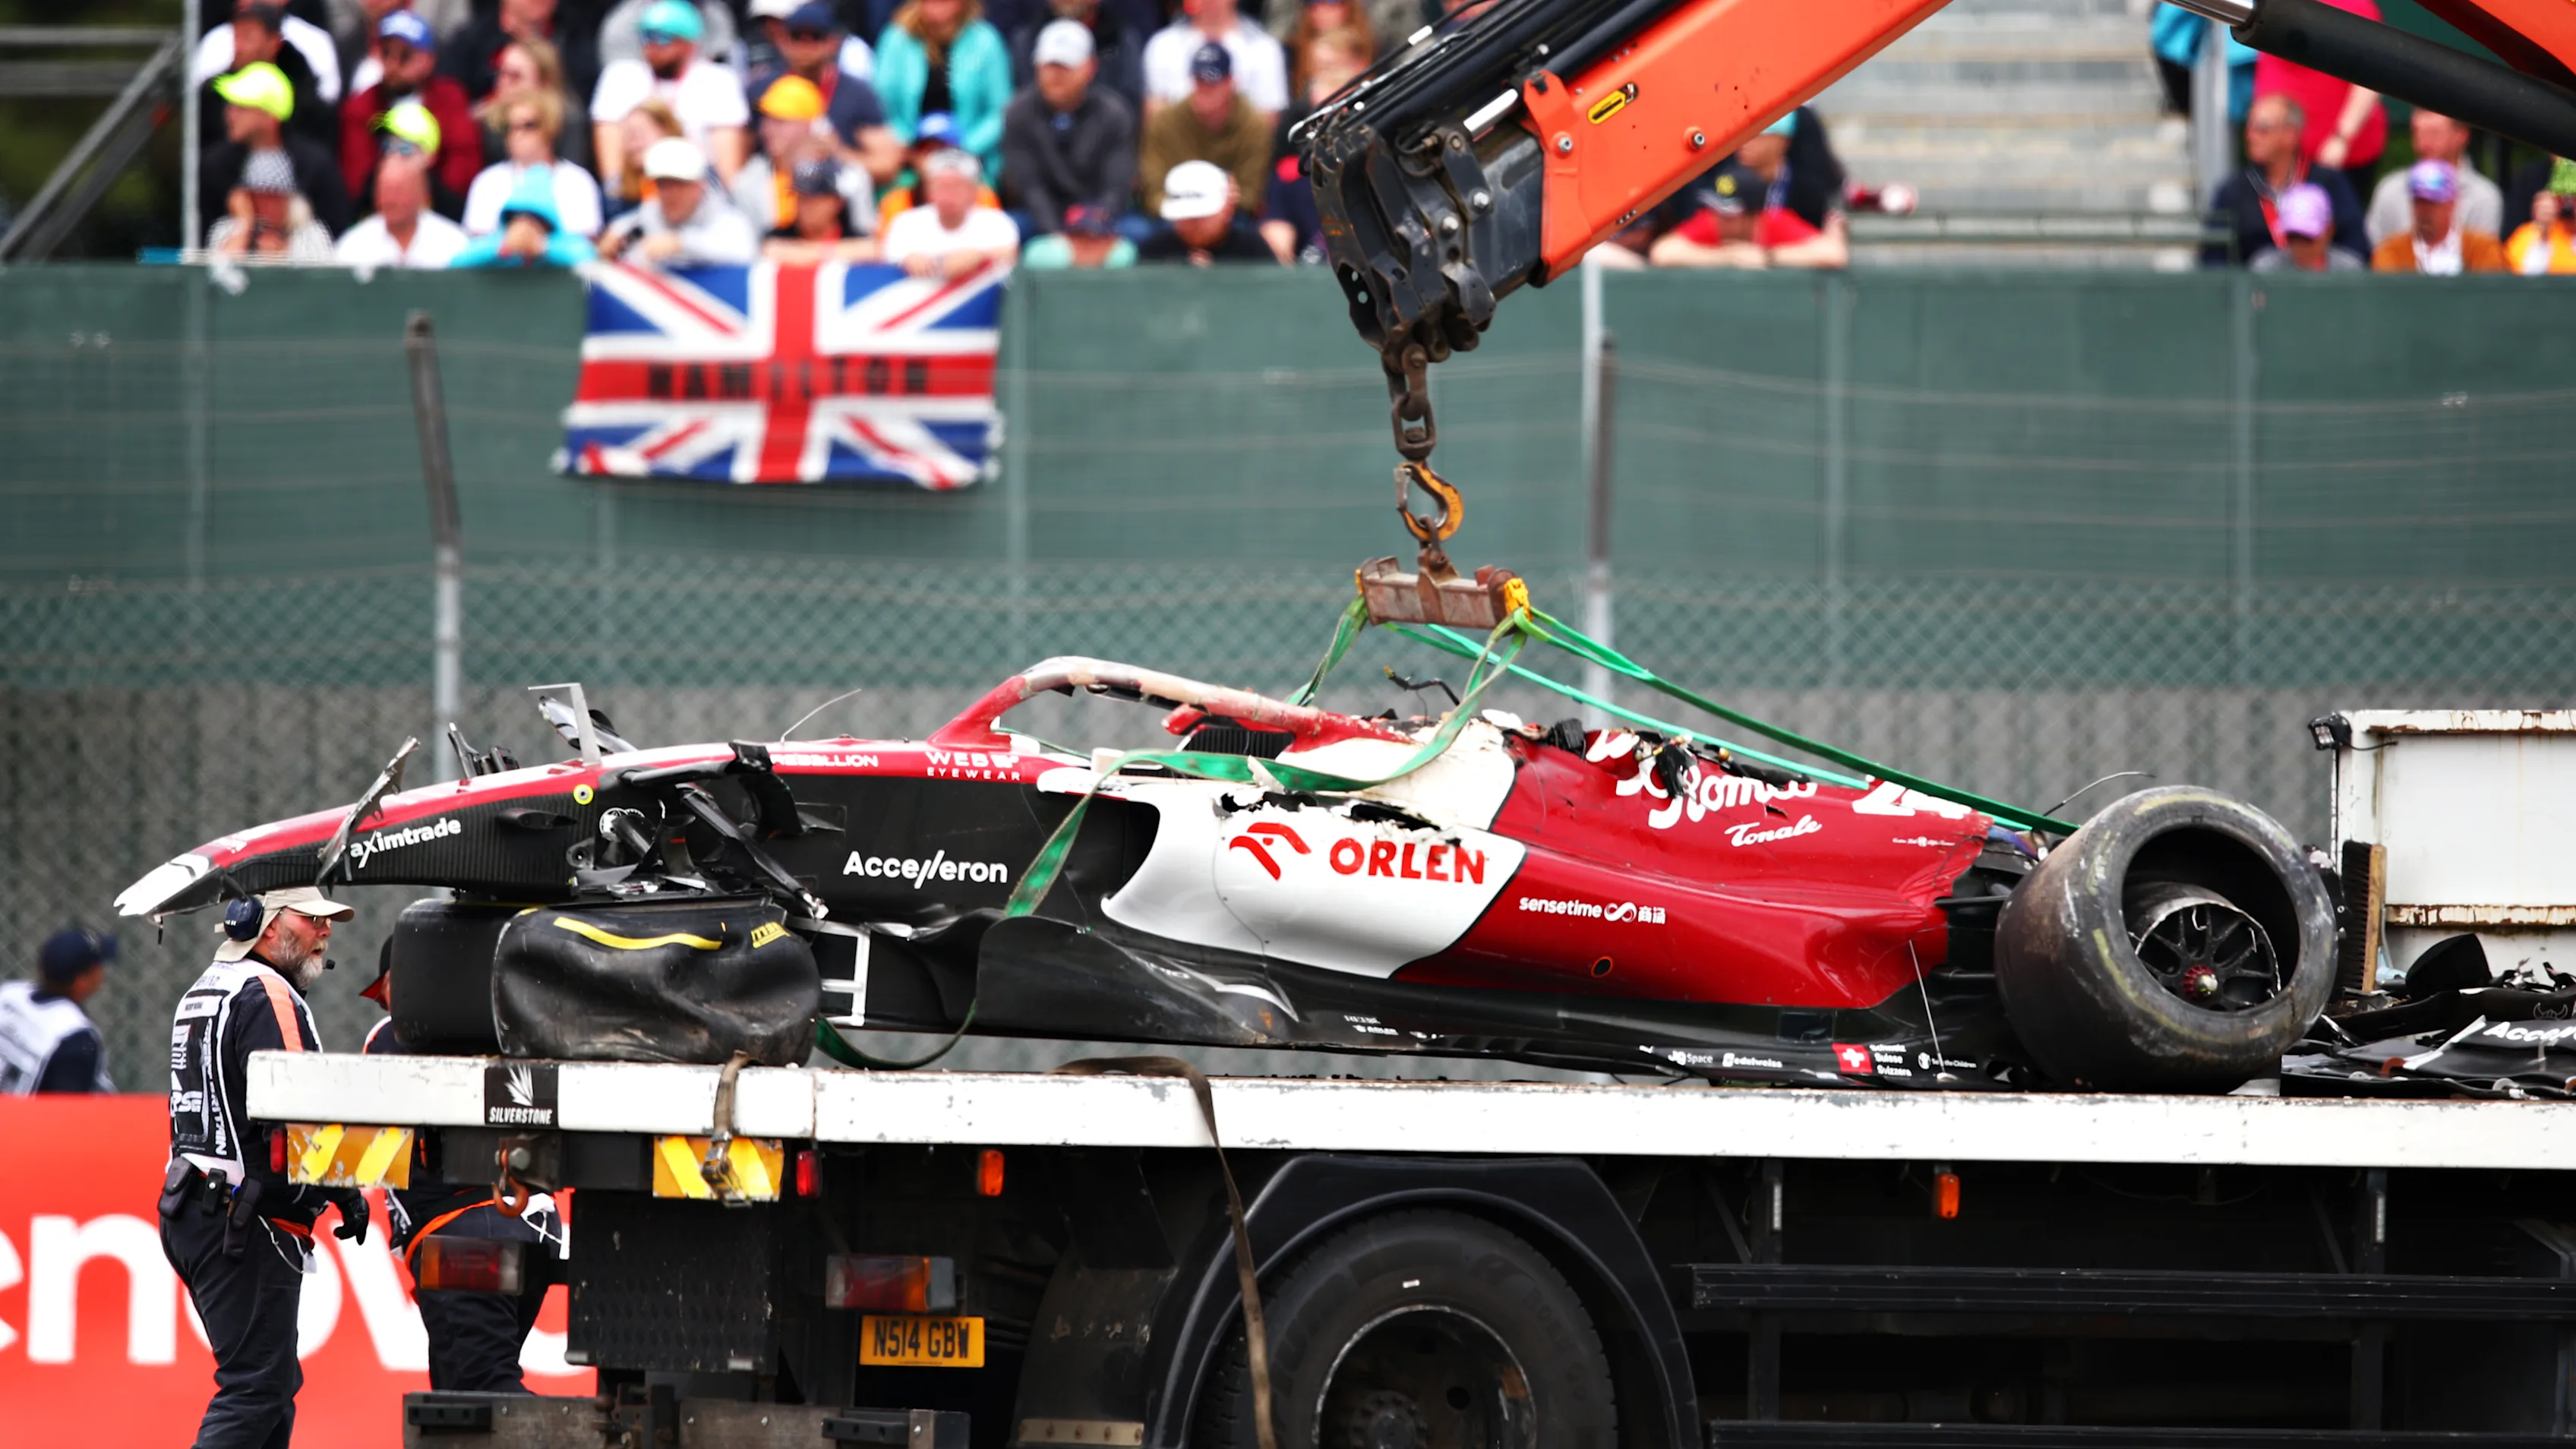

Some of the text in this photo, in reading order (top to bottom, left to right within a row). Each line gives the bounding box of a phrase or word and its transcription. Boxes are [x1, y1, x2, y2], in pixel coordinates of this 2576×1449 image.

[648, 355, 929, 400] HAMILTON
[927, 767, 1020, 781] EYEWEAR
[350, 817, 462, 869] aximtrade
[1725, 815, 1822, 847] Tonale
[1330, 838, 1485, 884] ORLEN
[1519, 897, 1602, 918] sensetime
[1874, 1053, 1903, 1064] Suisse
[488, 1106, 553, 1125] SILVERSTONE
[873, 1320, 969, 1359] N514 GBW
